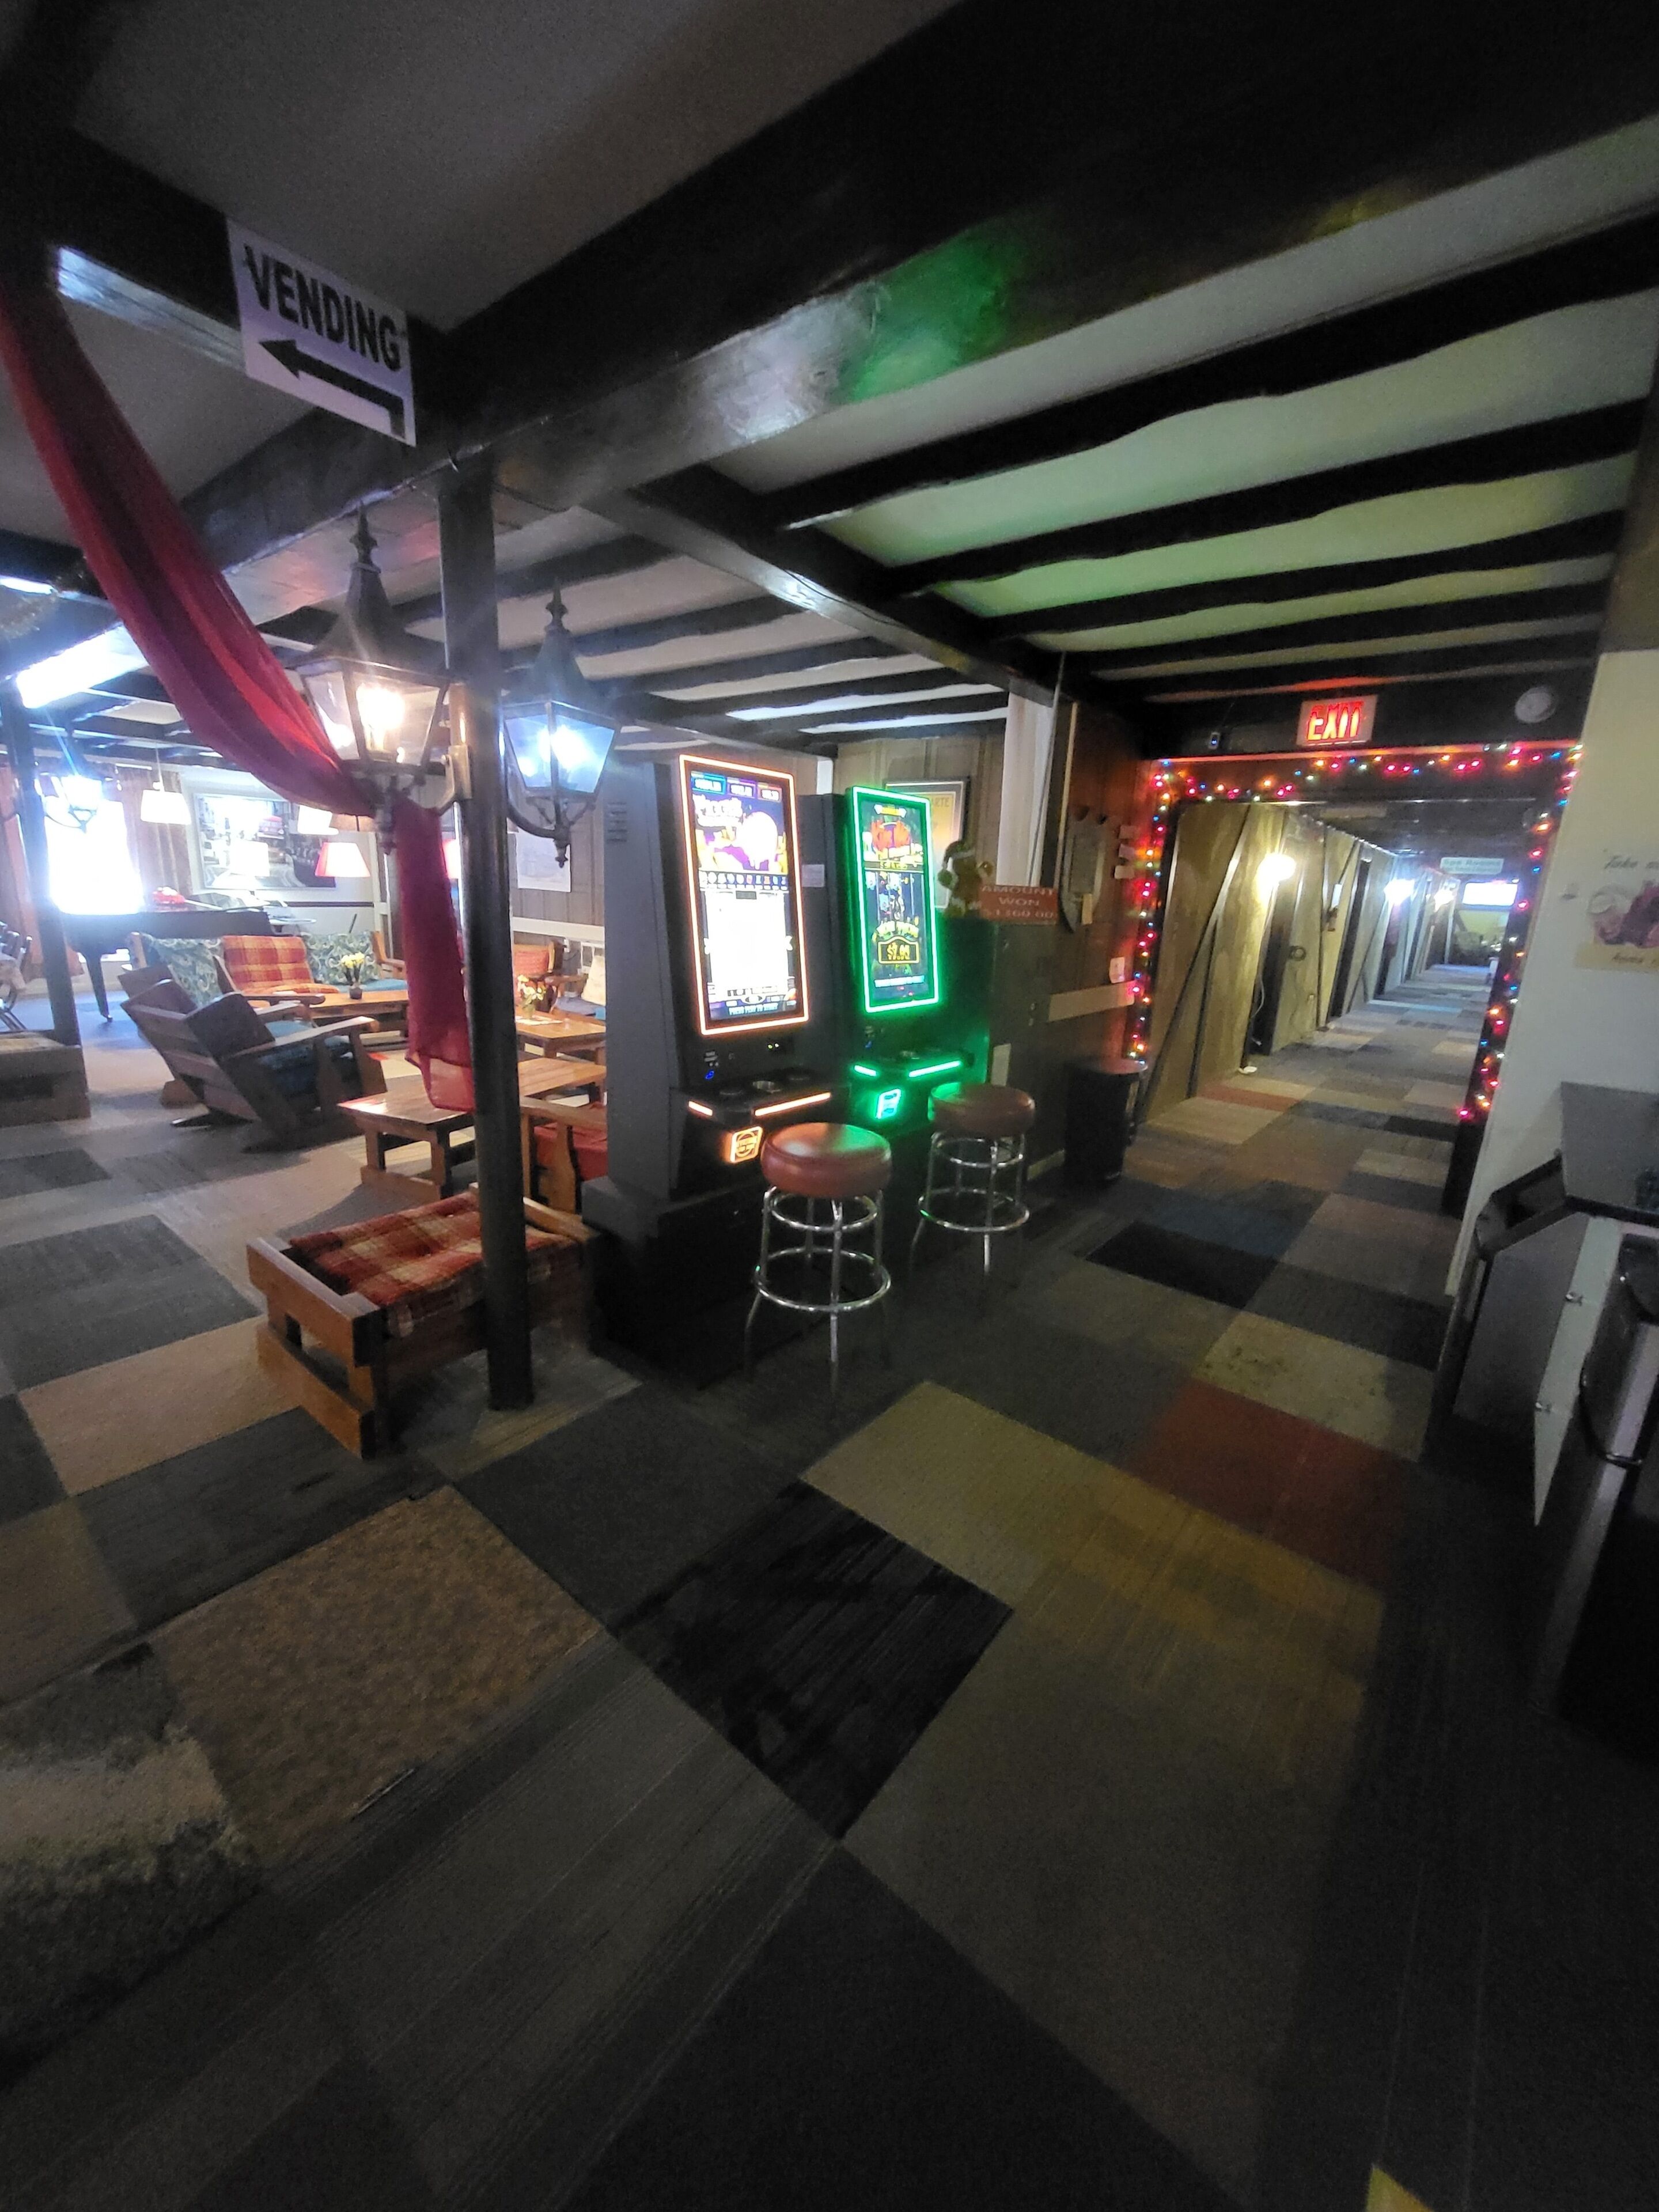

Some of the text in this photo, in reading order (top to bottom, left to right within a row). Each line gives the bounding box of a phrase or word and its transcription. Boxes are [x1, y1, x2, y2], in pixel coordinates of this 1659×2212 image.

[243, 243, 402, 372] VENDING
[1307, 701, 1365, 741] EXIT
[981, 885, 1054, 896] AMOUNT
[998, 897, 1040, 906] WON
